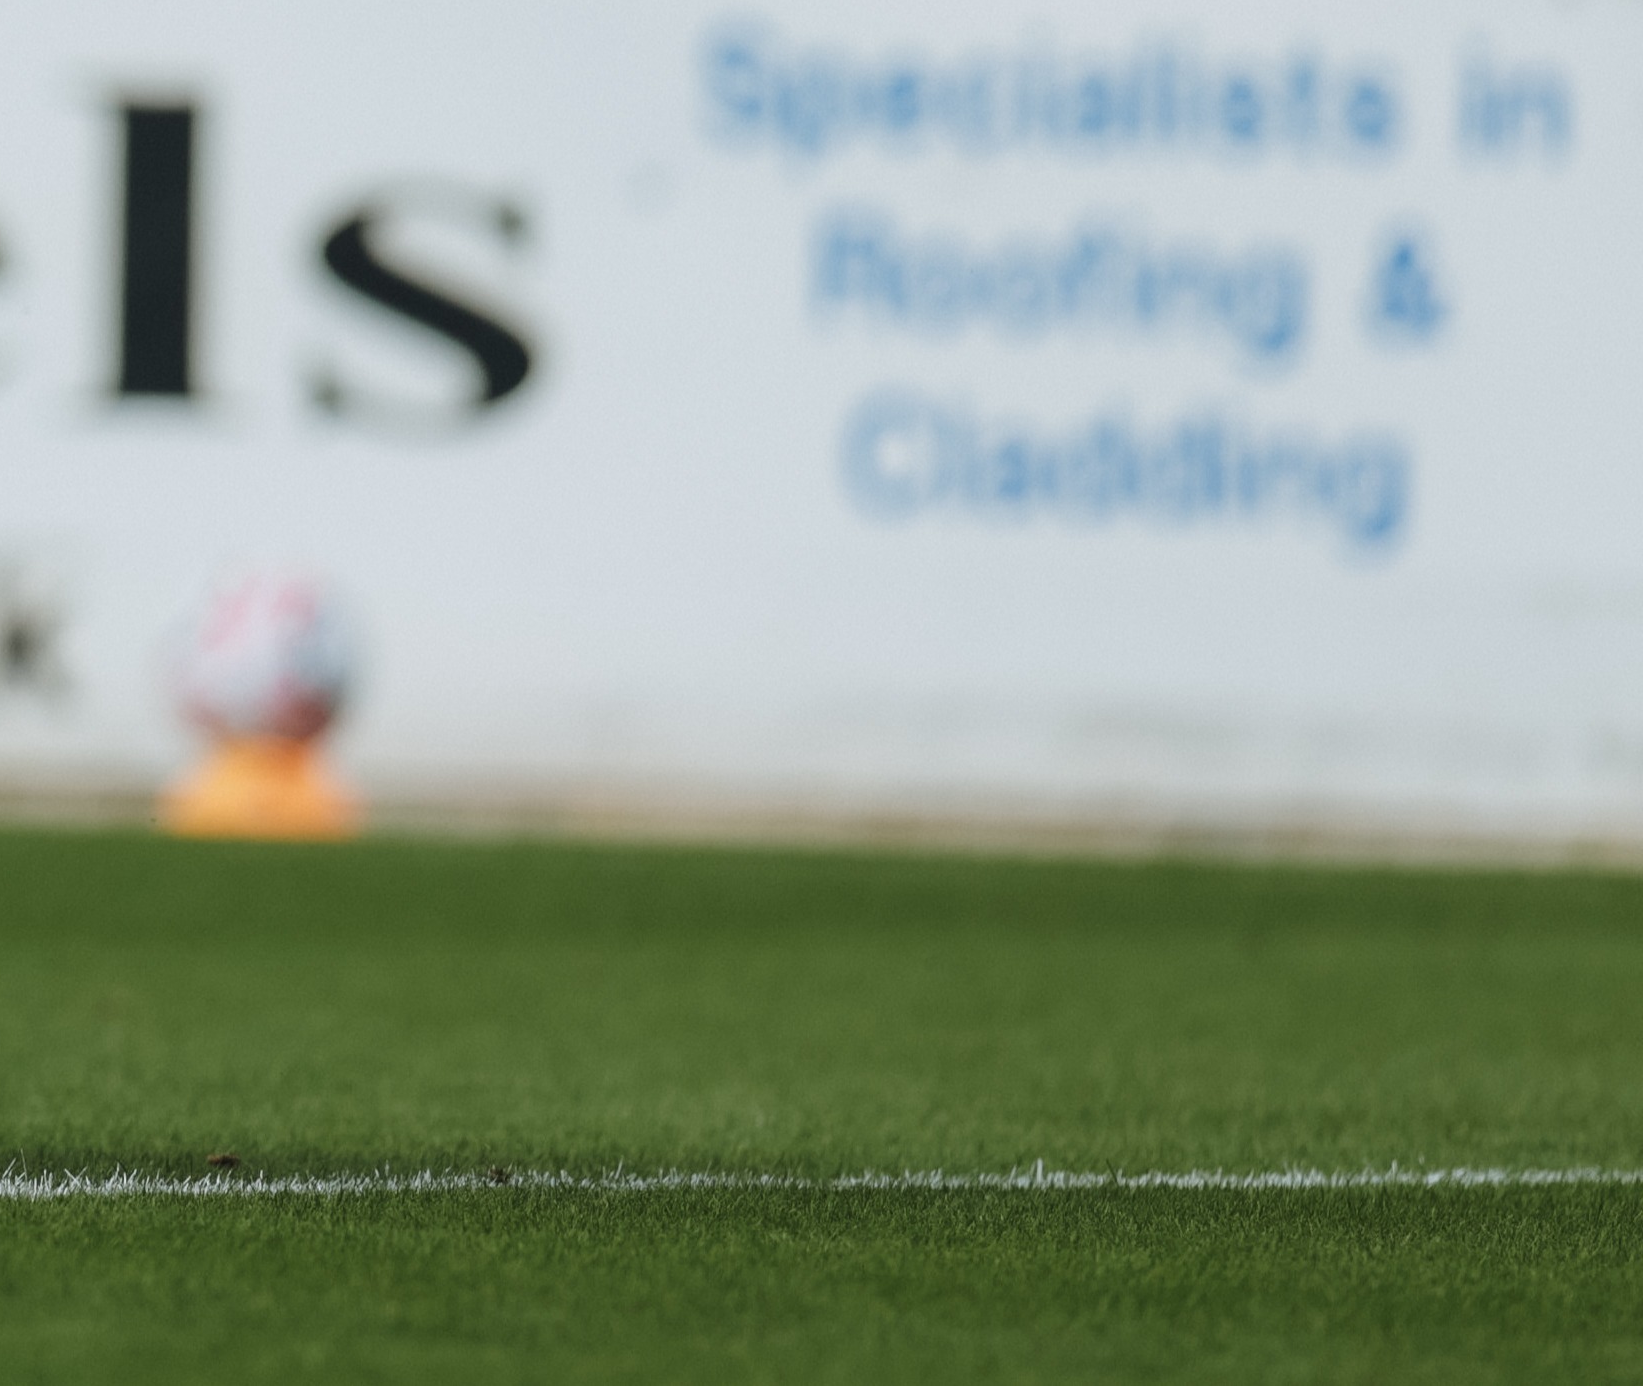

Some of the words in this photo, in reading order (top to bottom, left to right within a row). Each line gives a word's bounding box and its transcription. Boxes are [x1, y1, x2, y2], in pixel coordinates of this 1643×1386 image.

[705, 19, 1399, 172] Specialists
[1455, 26, 1572, 159] in
[810, 209, 1310, 374] Roofing
[1360, 219, 1451, 349] &
[840, 389, 1414, 559] Cladding
